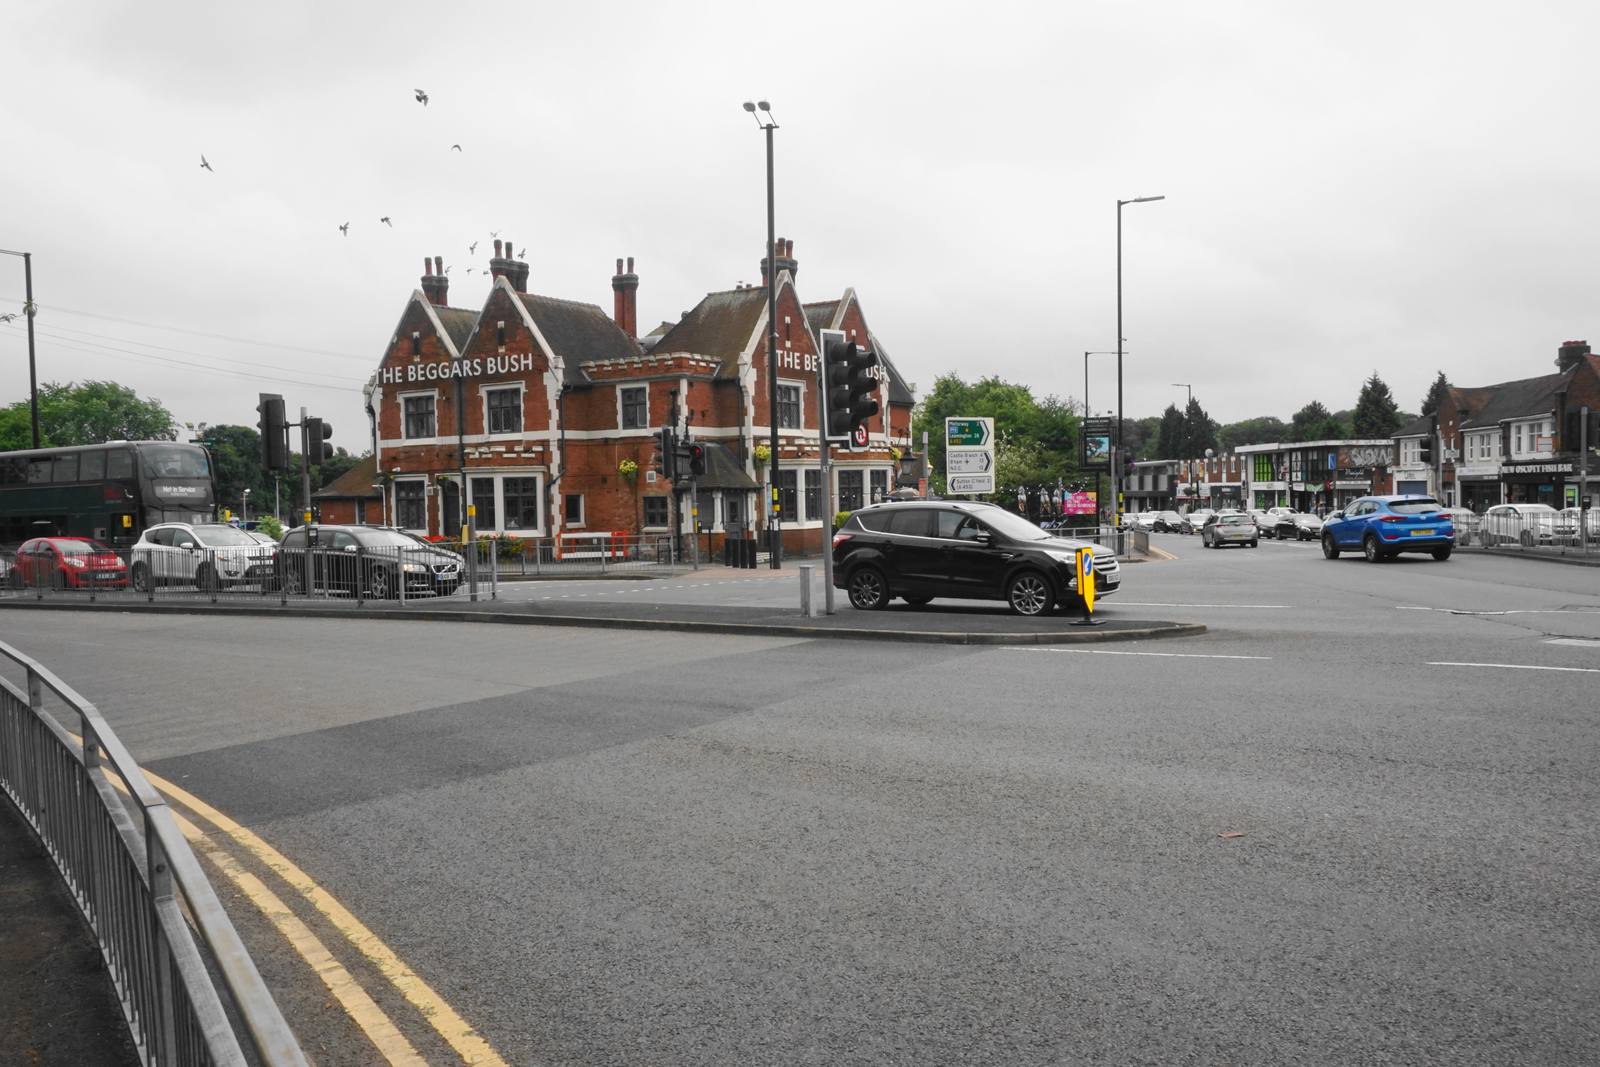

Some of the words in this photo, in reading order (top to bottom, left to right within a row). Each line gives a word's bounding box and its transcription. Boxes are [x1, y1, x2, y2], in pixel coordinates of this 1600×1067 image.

[376, 366, 402, 384] THE
[408, 358, 482, 382] BEGGARS
[487, 353, 533, 375] BUSH
[776, 349, 801, 370] THE
